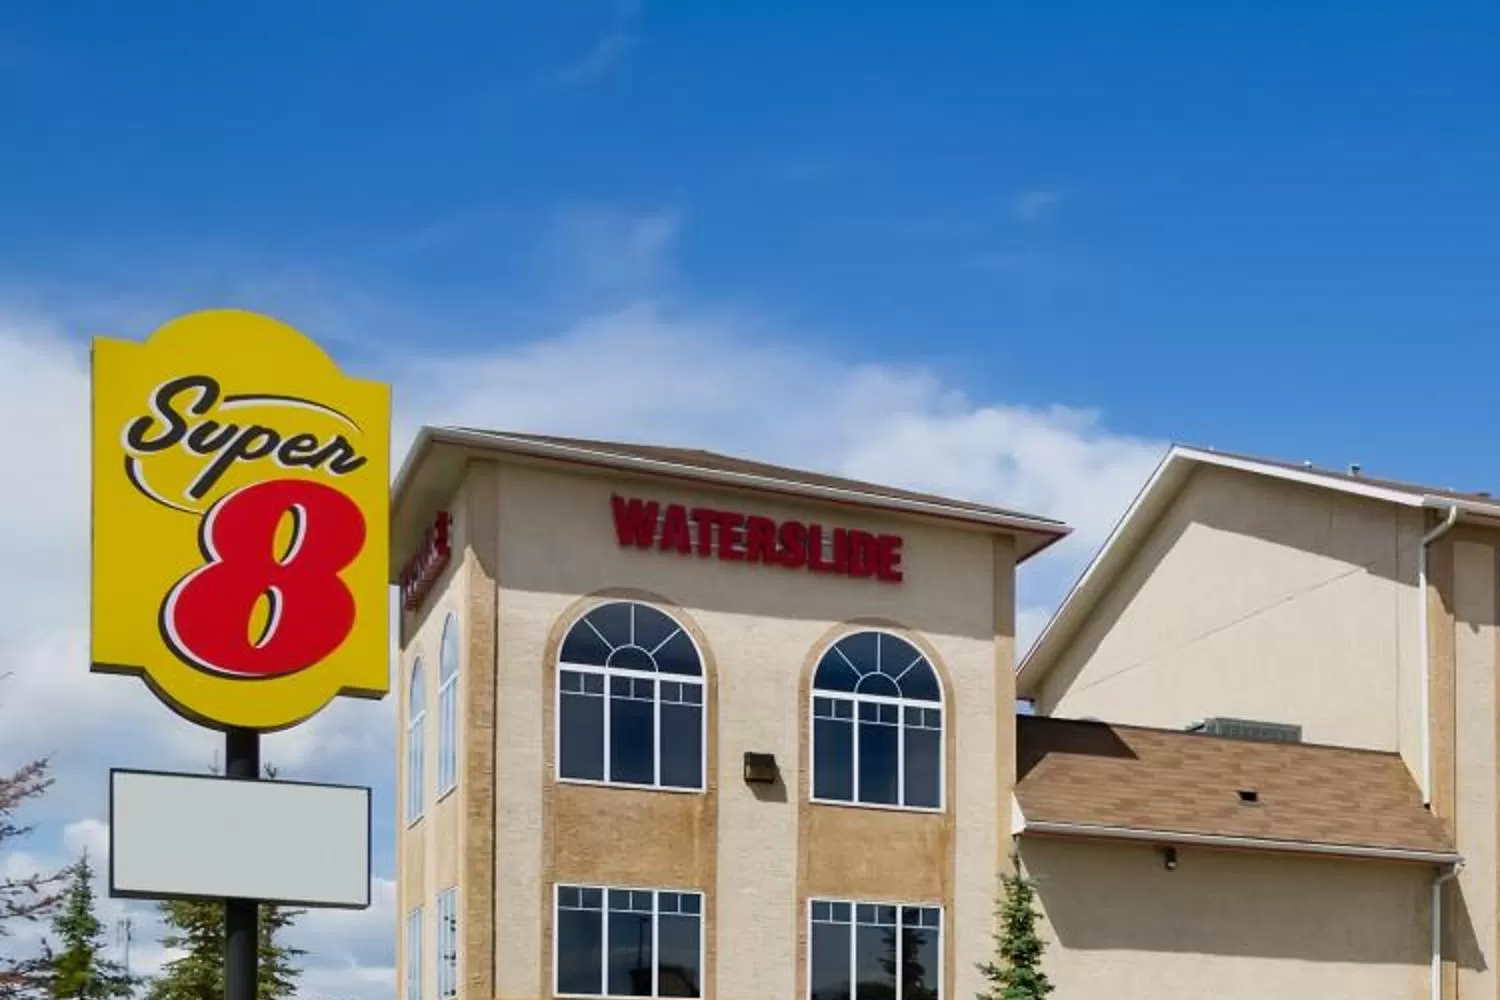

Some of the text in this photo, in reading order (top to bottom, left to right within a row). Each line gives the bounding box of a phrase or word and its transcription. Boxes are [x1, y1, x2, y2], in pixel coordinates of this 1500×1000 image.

[126, 375, 367, 498] Super
[160, 479, 367, 680] 8
[611, 494, 904, 583] WATERSLIDE
